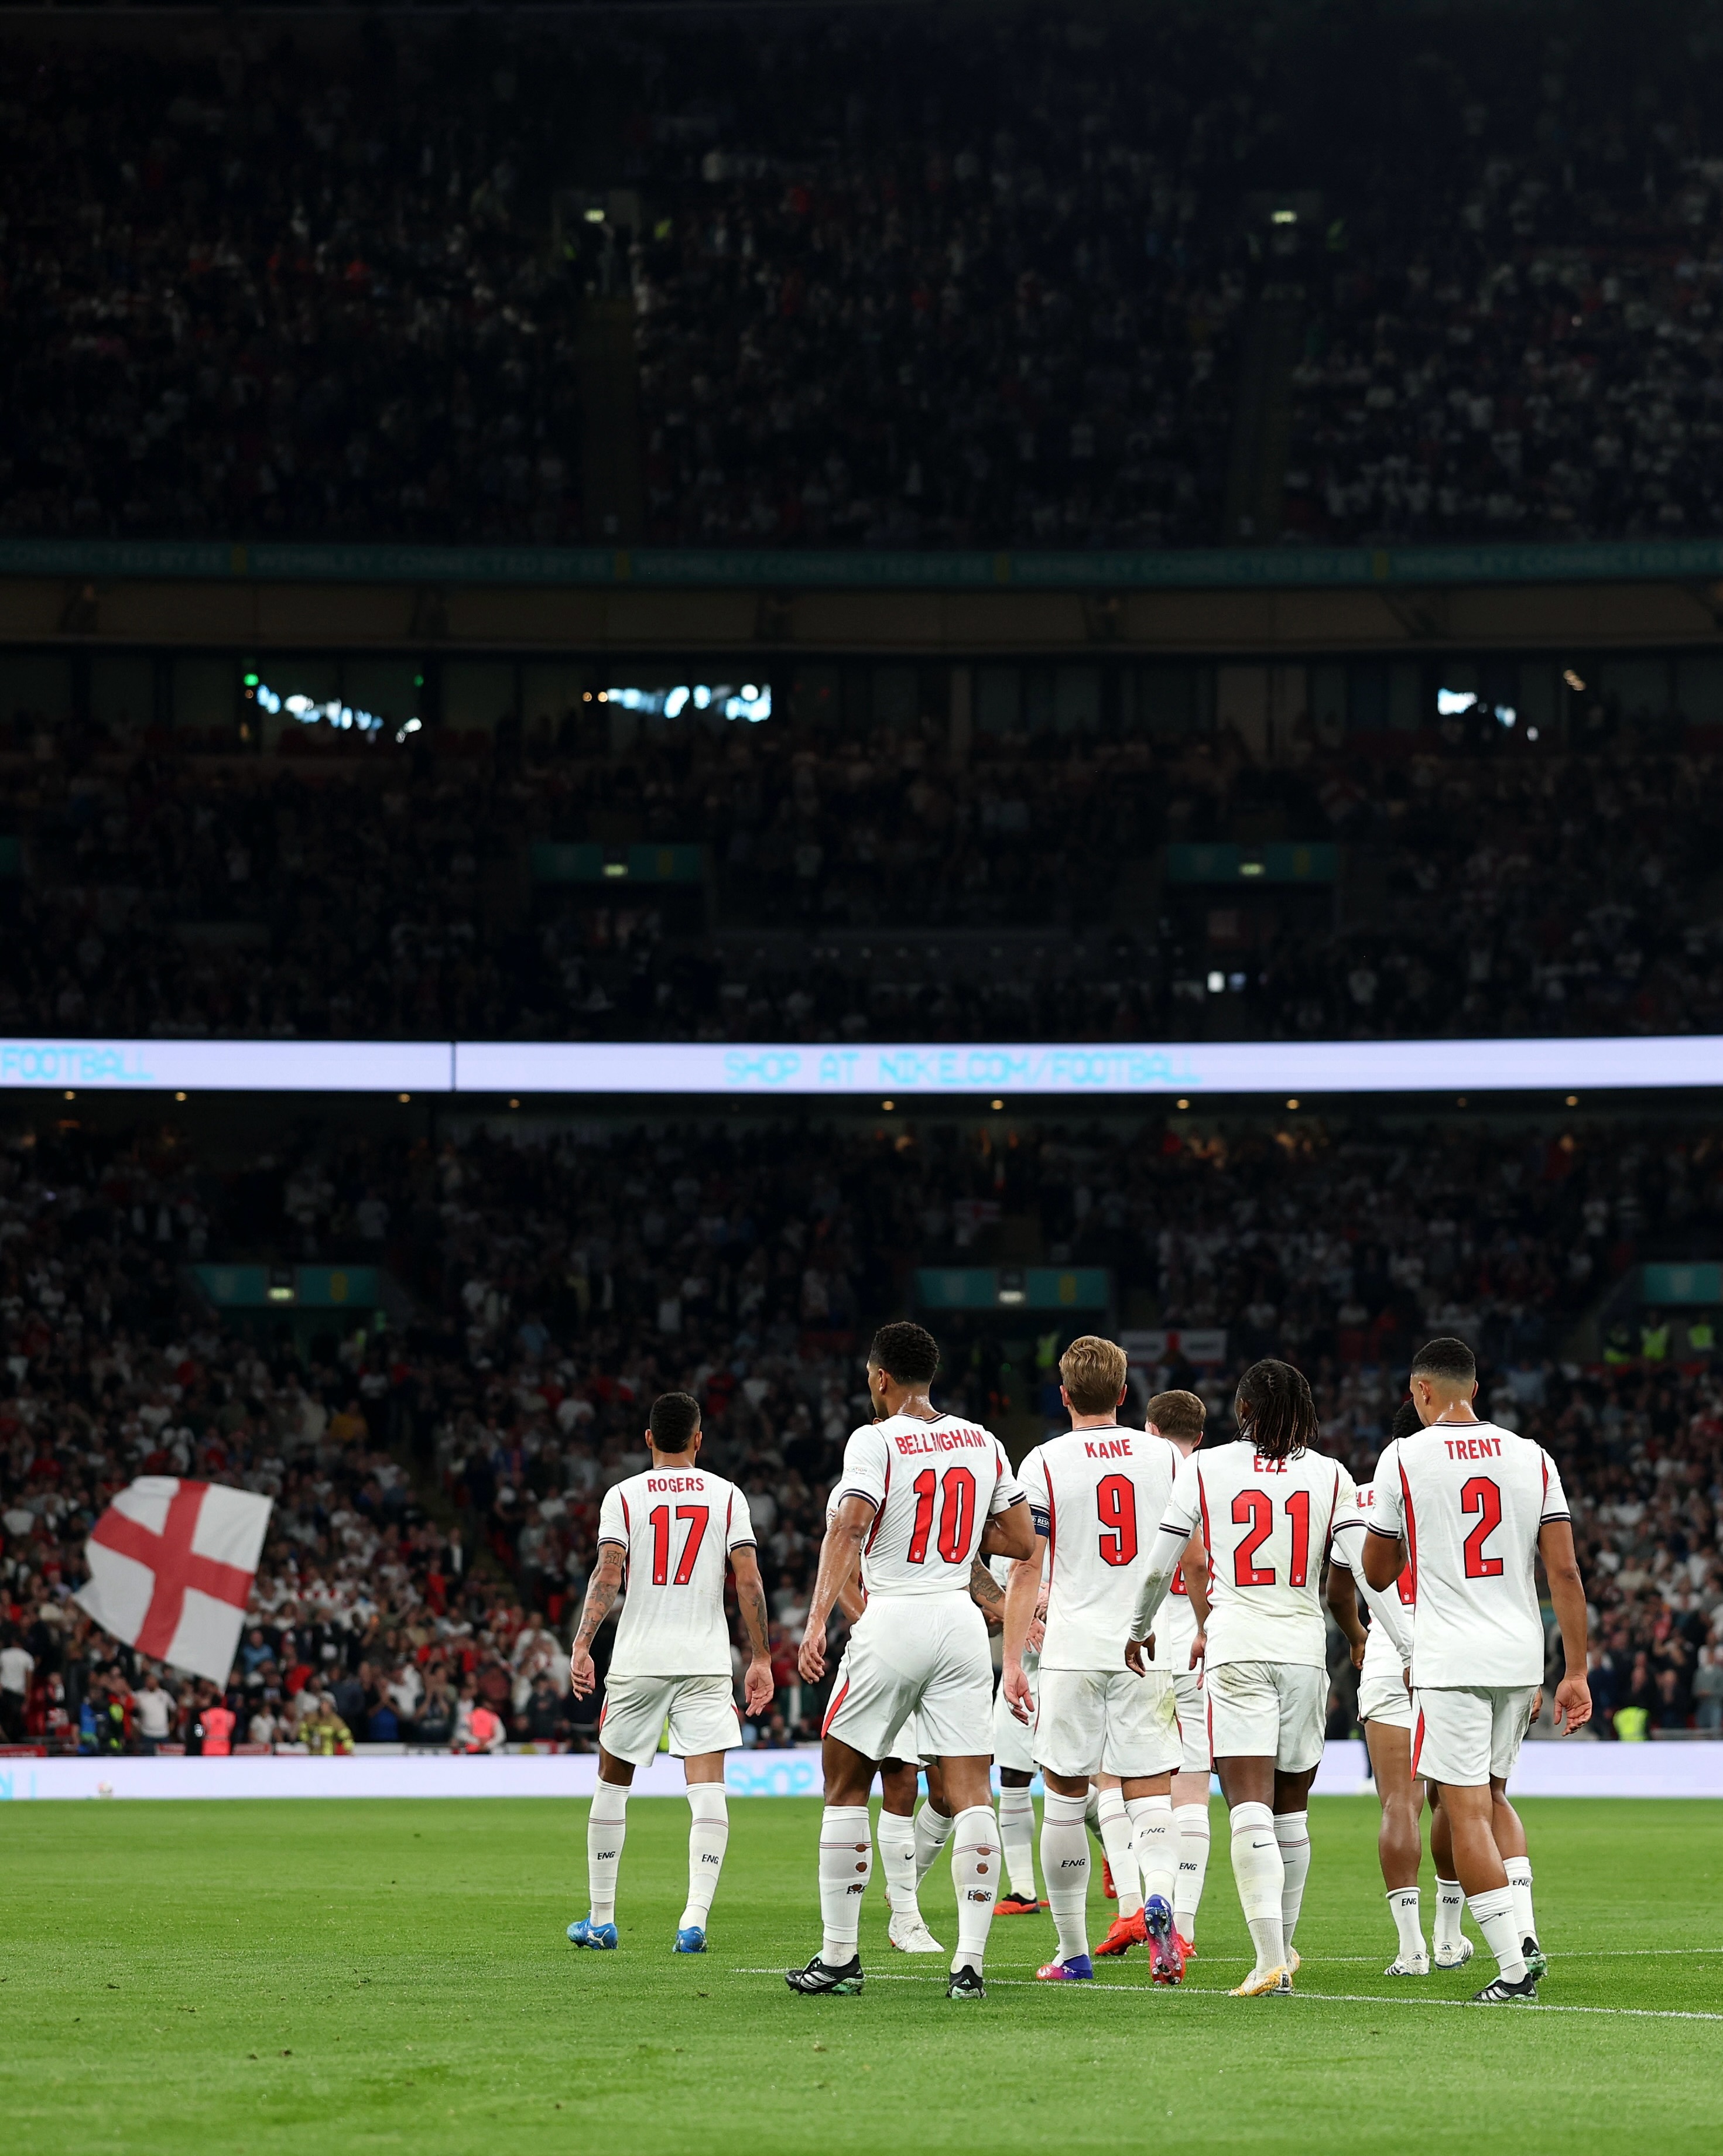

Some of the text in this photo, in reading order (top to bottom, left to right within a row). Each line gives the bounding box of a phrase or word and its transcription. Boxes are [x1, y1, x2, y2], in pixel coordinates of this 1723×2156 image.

[2, 1046, 155, 1080] FOOTBALL
[724, 1051, 1201, 1085] SHOP AT NIKE.COM/FOOTBALL
[895, 1429, 986, 1455] BELLINGHAM
[1084, 1439, 1133, 1459] KANE
[1444, 1438, 1501, 1459] TRENT
[1253, 1455, 1287, 1472] EZE
[647, 1477, 704, 1493] ROGERS
[907, 1467, 976, 1564] 10
[1097, 1474, 1138, 1566] 9
[1231, 1489, 1309, 1587] 21
[1461, 1476, 1503, 1579] 2
[649, 1505, 709, 1585] 17
[727, 1761, 814, 1796] SHOP
[1140, 1828, 1165, 1838] ENG
[597, 1852, 615, 1860] ENG
[701, 1853, 720, 1865] ENG
[1061, 1859, 1085, 1867] ENG
[1513, 1879, 1529, 1887] ENG
[1402, 1898, 1417, 1907] ENG
